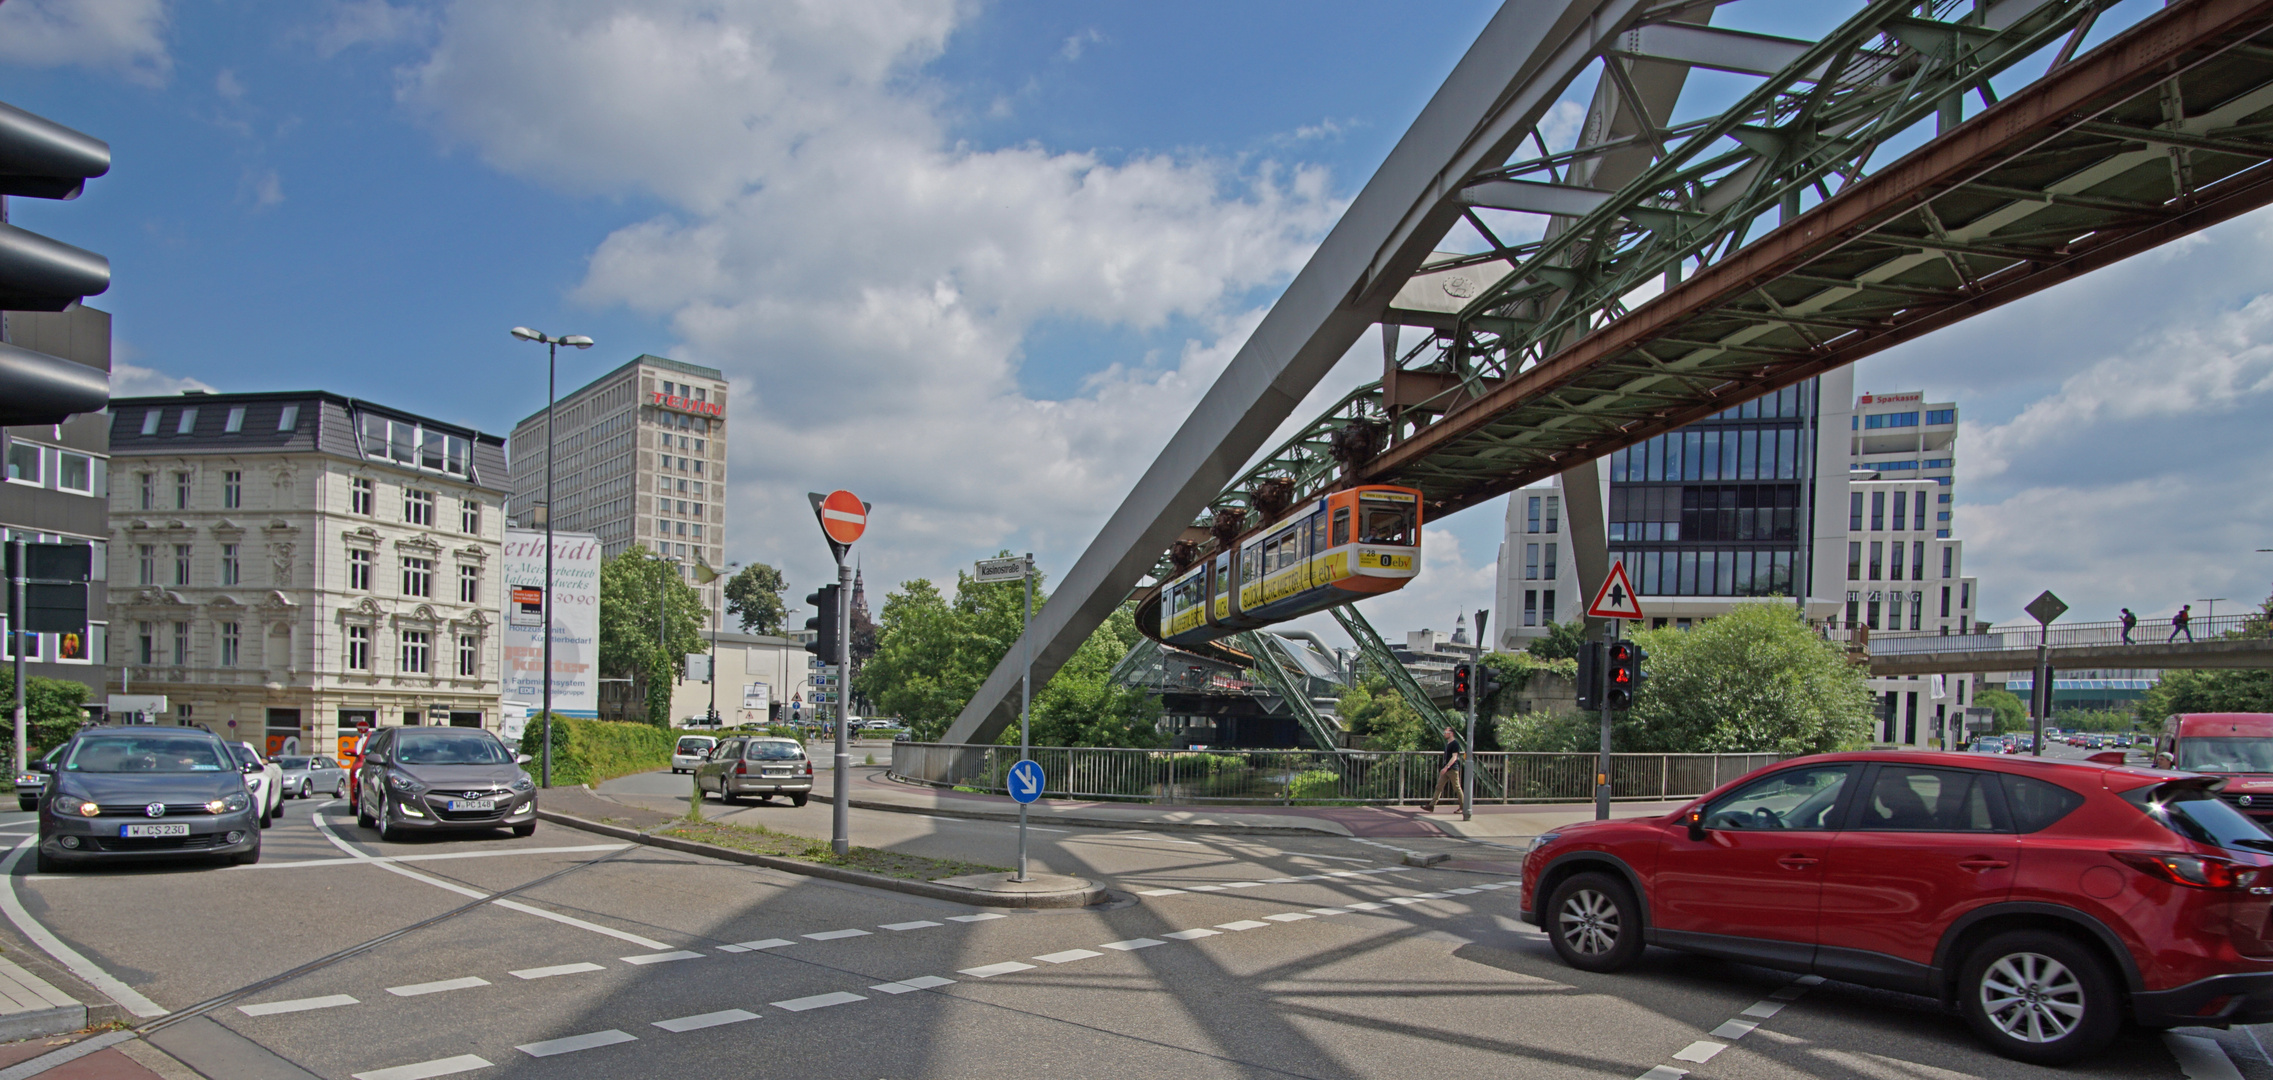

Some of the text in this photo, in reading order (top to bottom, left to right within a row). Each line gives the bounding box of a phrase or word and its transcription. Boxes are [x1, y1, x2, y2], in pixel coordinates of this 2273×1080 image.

[650, 391, 723, 416] TEIJIN
[1876, 395, 1919, 404] Sparkasse
[981, 563, 1020, 576] Kasinostraße
[1867, 591, 1920, 602] ZEITUNG
[132, 825, 185, 835] W CS 230
